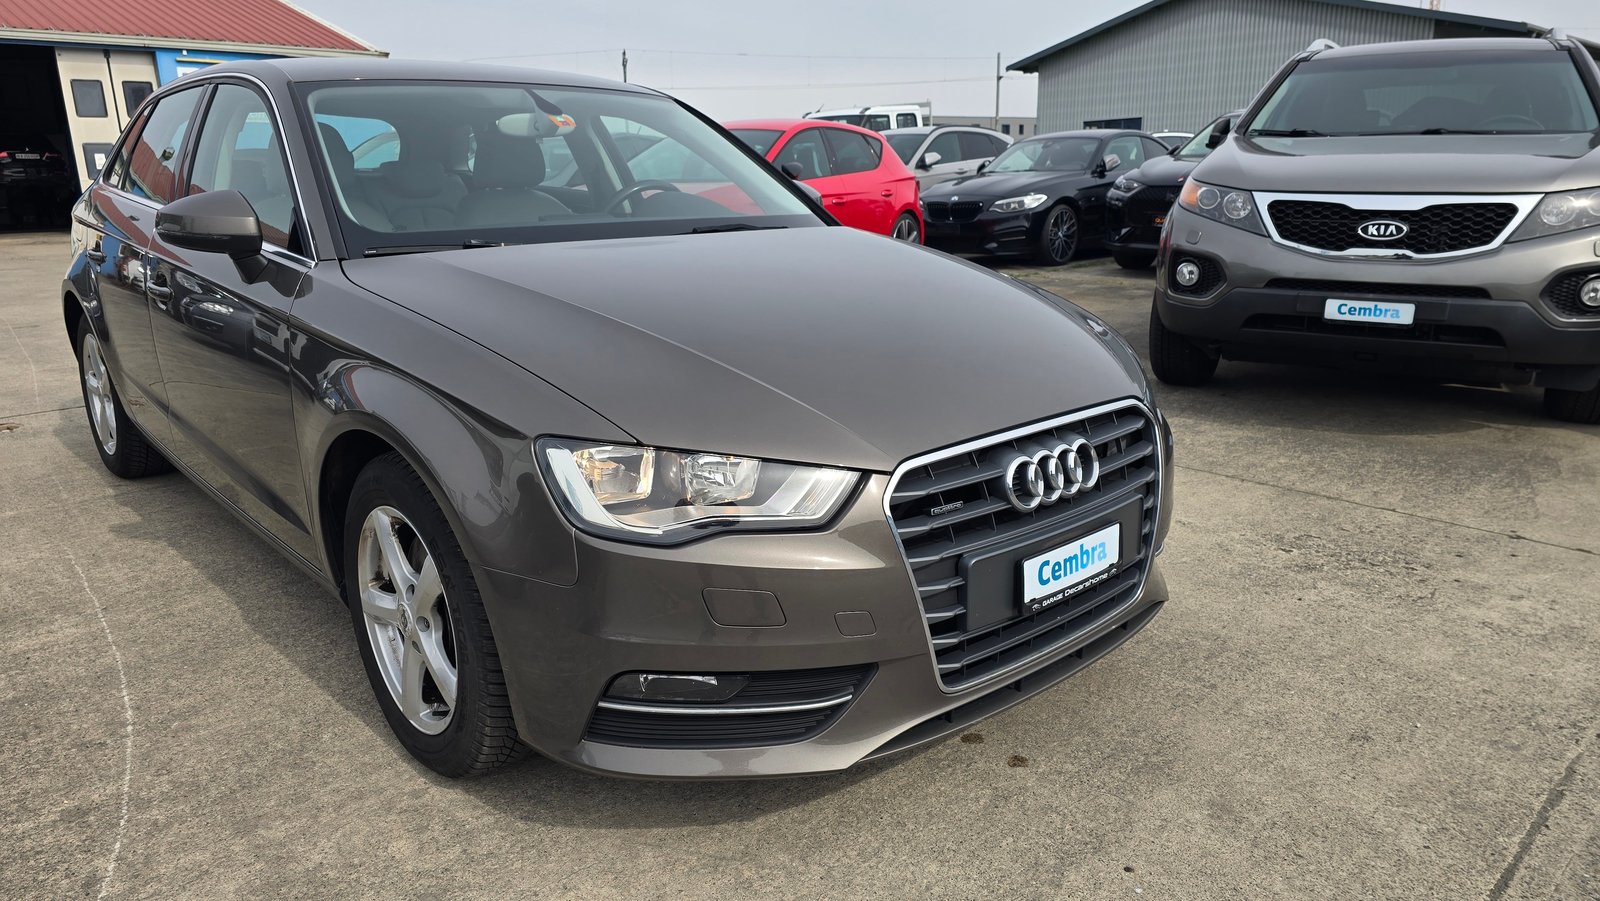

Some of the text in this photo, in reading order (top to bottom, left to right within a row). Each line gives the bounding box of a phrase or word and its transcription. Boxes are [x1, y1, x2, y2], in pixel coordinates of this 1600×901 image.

[1367, 224, 1397, 236] KIA
[1337, 303, 1401, 319] Cembra
[1038, 541, 1107, 586] Cembra
[1042, 572, 1108, 607] GARAGE Decarshome
